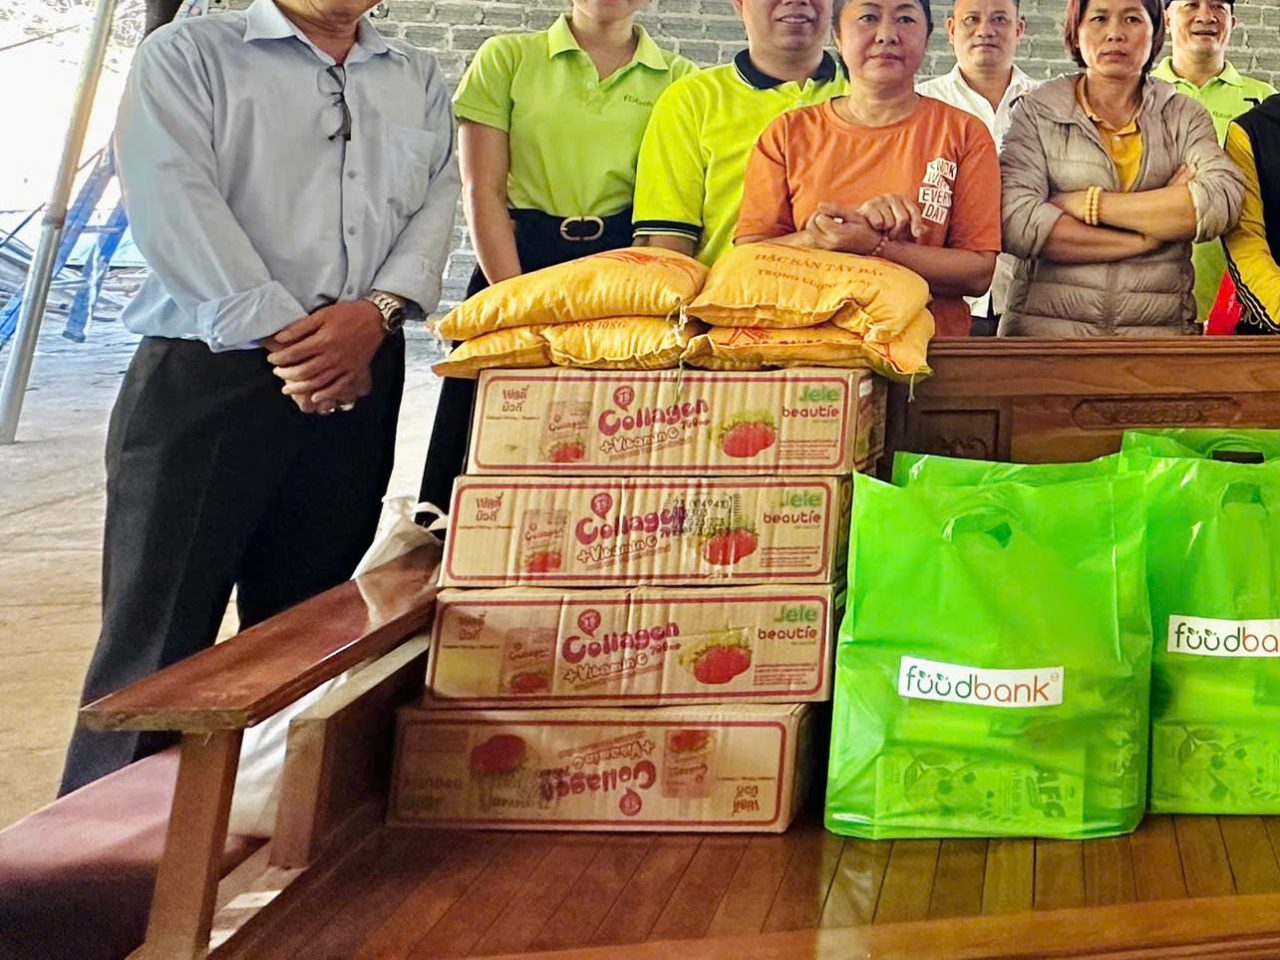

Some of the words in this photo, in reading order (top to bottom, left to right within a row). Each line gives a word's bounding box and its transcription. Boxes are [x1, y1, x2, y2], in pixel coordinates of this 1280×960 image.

[925, 203, 946, 222] DAY
[800, 385, 839, 402] Jele
[598, 398, 709, 437] Collagen
[781, 404, 840, 419] beautie
[763, 510, 822, 524] beautie
[774, 605, 818, 623] Jele
[757, 625, 818, 640] beautie
[562, 621, 680, 664] Collagen
